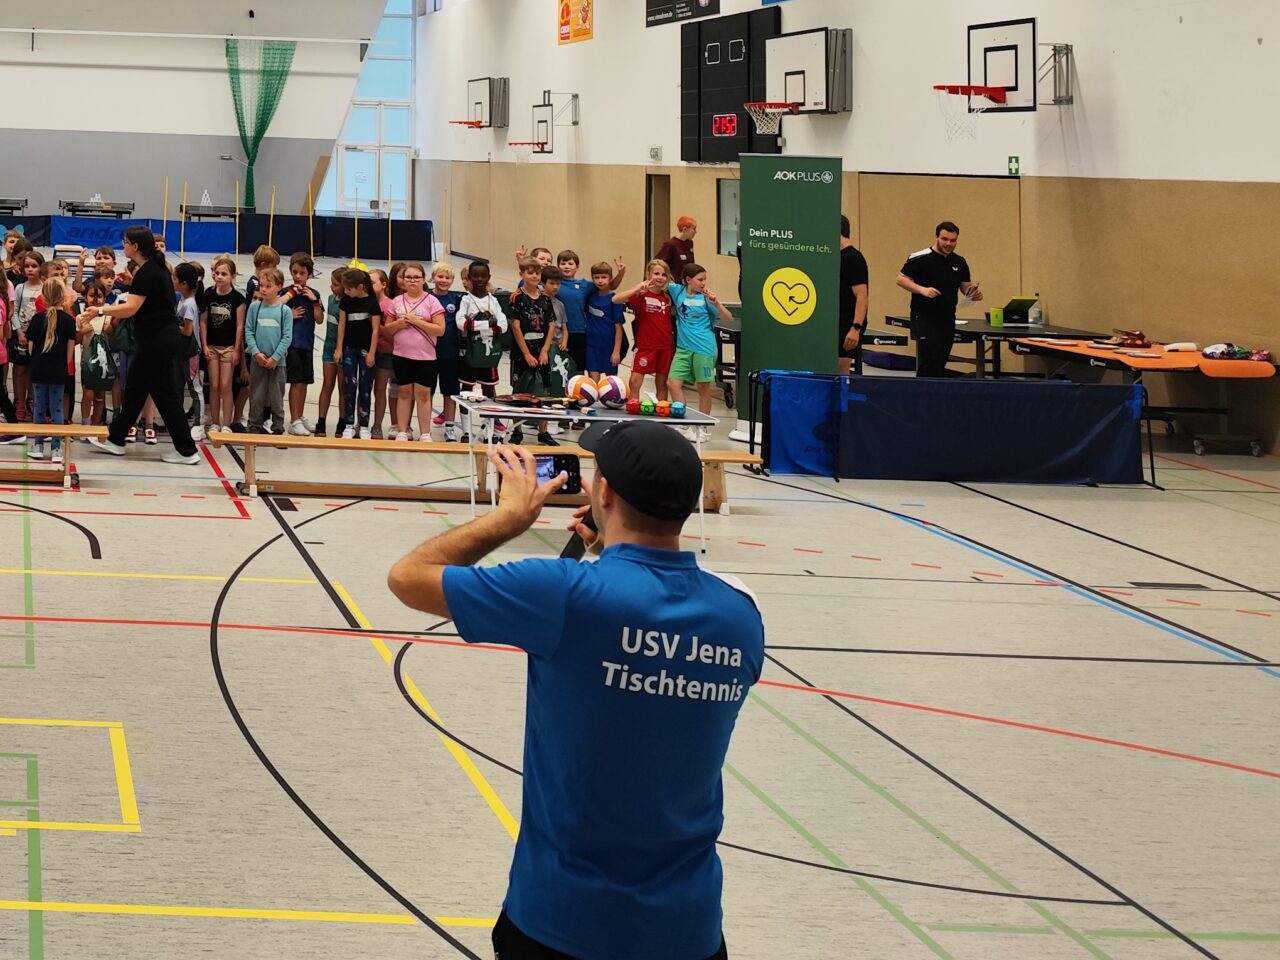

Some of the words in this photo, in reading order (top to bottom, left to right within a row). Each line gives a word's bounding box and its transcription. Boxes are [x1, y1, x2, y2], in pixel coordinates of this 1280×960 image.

[773, 170, 797, 181] AOK
[797, 171, 821, 182] PLUS
[749, 228, 769, 237] Dein
[770, 229, 793, 239] PLUS
[749, 240, 766, 248] fürs
[767, 242, 815, 252] gesündere
[816, 244, 833, 254] Ich.
[621, 626, 681, 660] USV
[685, 636, 742, 668] Jena
[601, 661, 744, 702] Tischtennis
